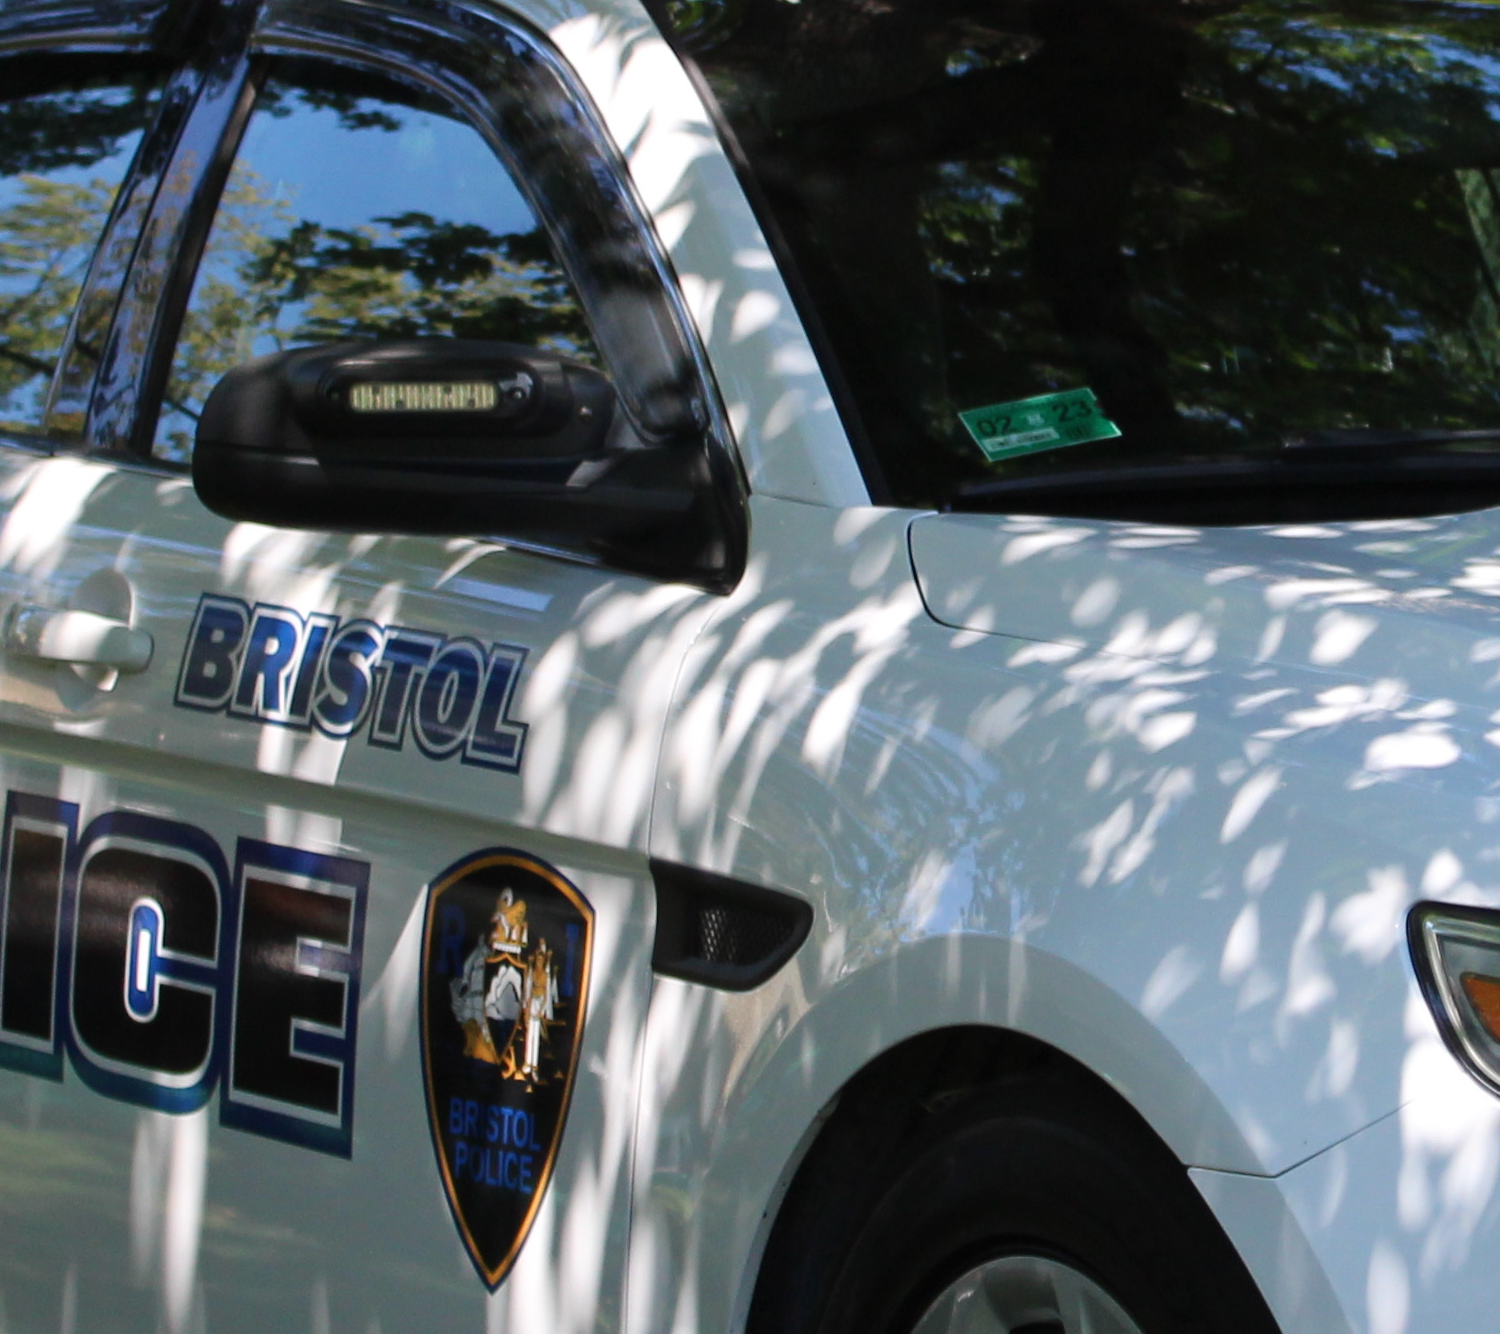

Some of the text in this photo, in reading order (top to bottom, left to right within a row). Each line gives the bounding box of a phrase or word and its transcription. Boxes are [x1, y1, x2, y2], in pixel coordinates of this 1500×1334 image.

[1053, 401, 1092, 422] 23
[175, 593, 528, 772] BRISTOL
[439, 903, 466, 975] R
[449, 1098, 541, 1151] BRISTOL
[454, 1145, 534, 1194] POLICE
